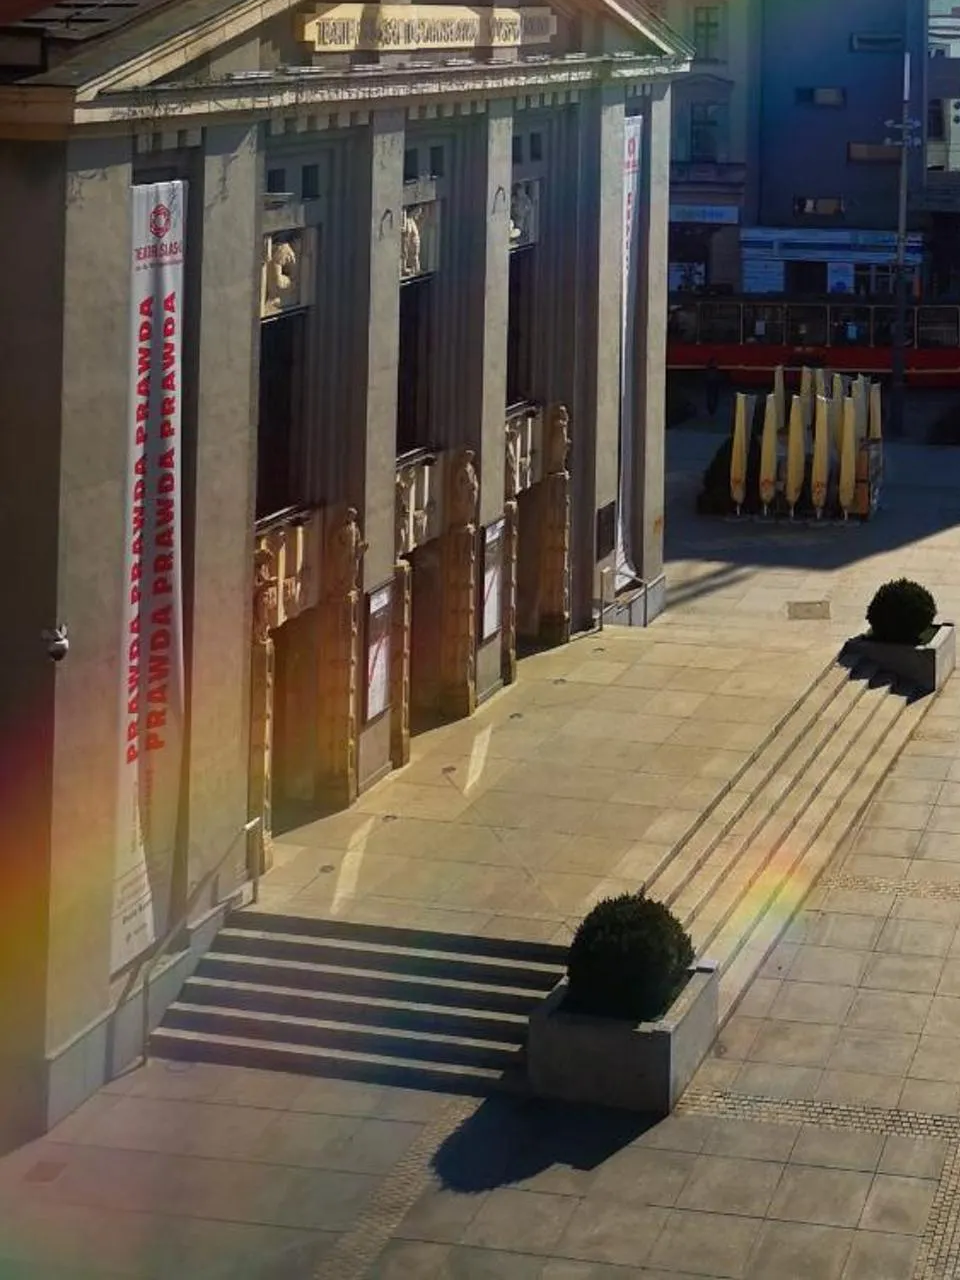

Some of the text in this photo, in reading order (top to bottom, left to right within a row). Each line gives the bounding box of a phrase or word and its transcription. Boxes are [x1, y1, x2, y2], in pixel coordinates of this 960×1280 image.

[136, 296, 153, 445] PRAWDA
[131, 454, 147, 604] PRAWDA
[145, 291, 176, 751] PRAWDA PRAWDA PRAWDA
[127, 615, 140, 764] PRAWDA
